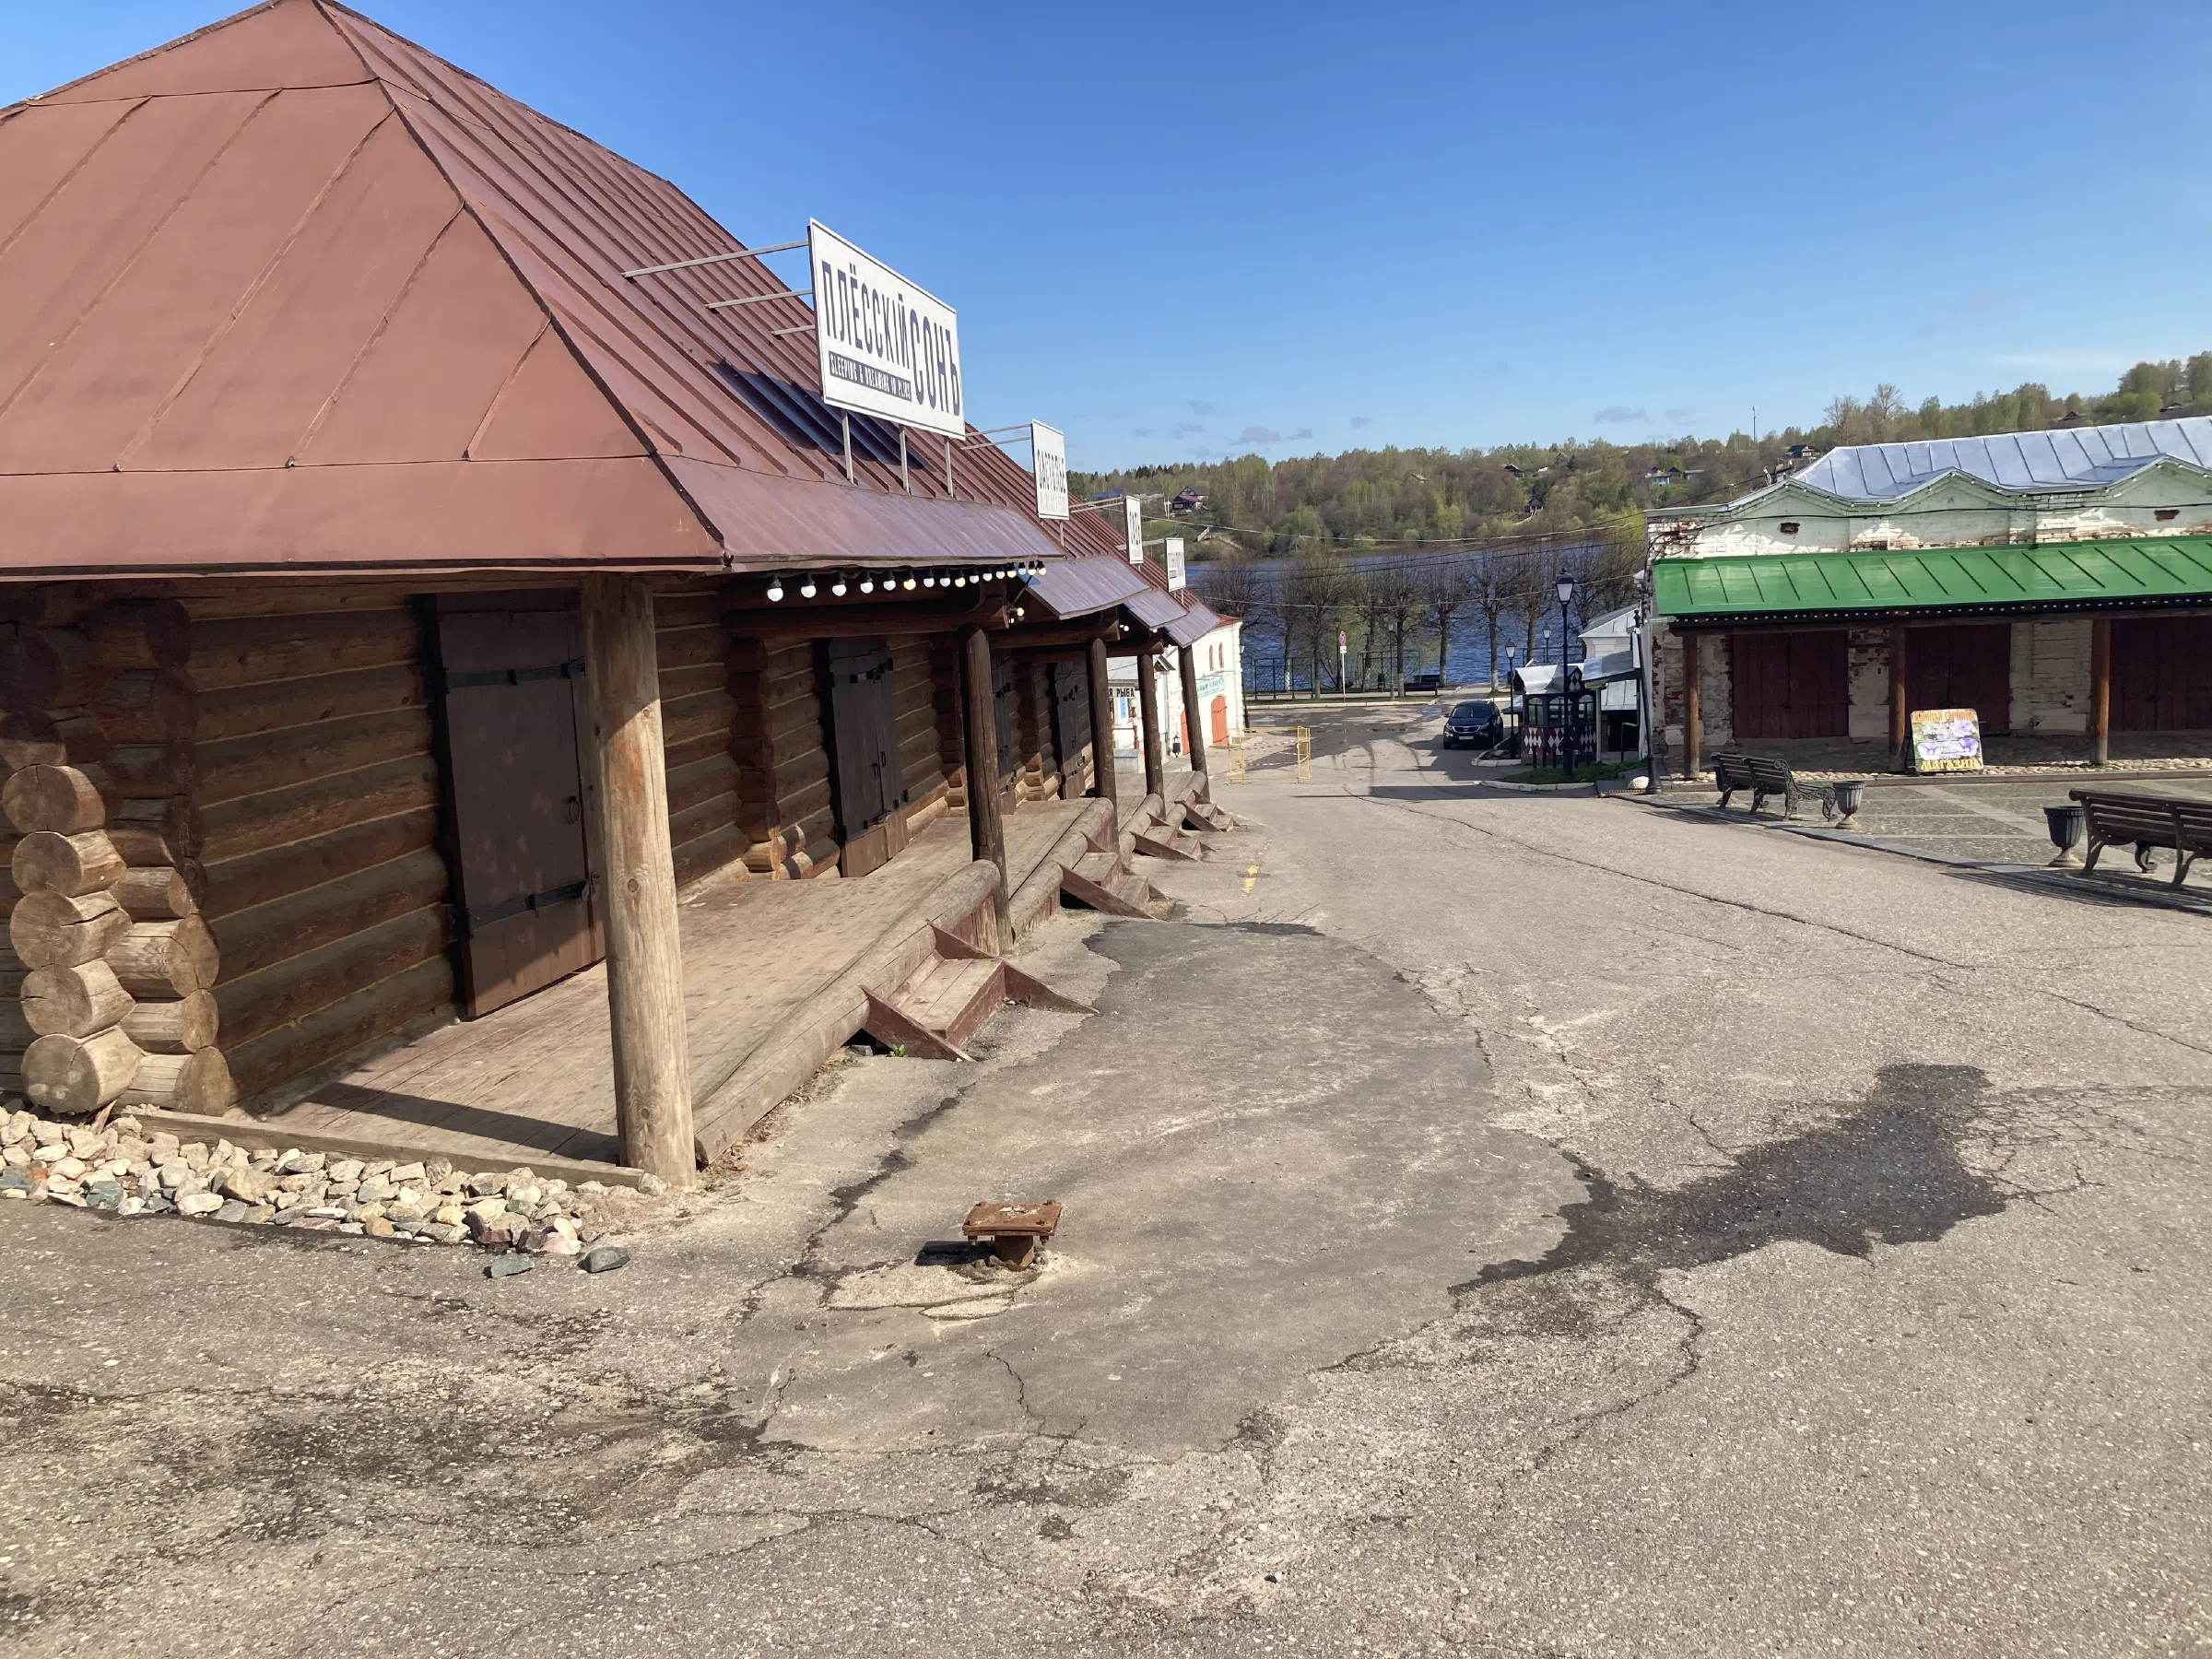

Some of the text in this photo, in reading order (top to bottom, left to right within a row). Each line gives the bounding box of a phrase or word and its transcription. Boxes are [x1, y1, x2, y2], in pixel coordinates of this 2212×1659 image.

[830, 354, 857, 381] SLEEPING
[910, 309, 960, 416] СОНЪ
[1116, 688, 1135, 697] РЫБА
[1921, 759, 1977, 771] МАГАЗИН
